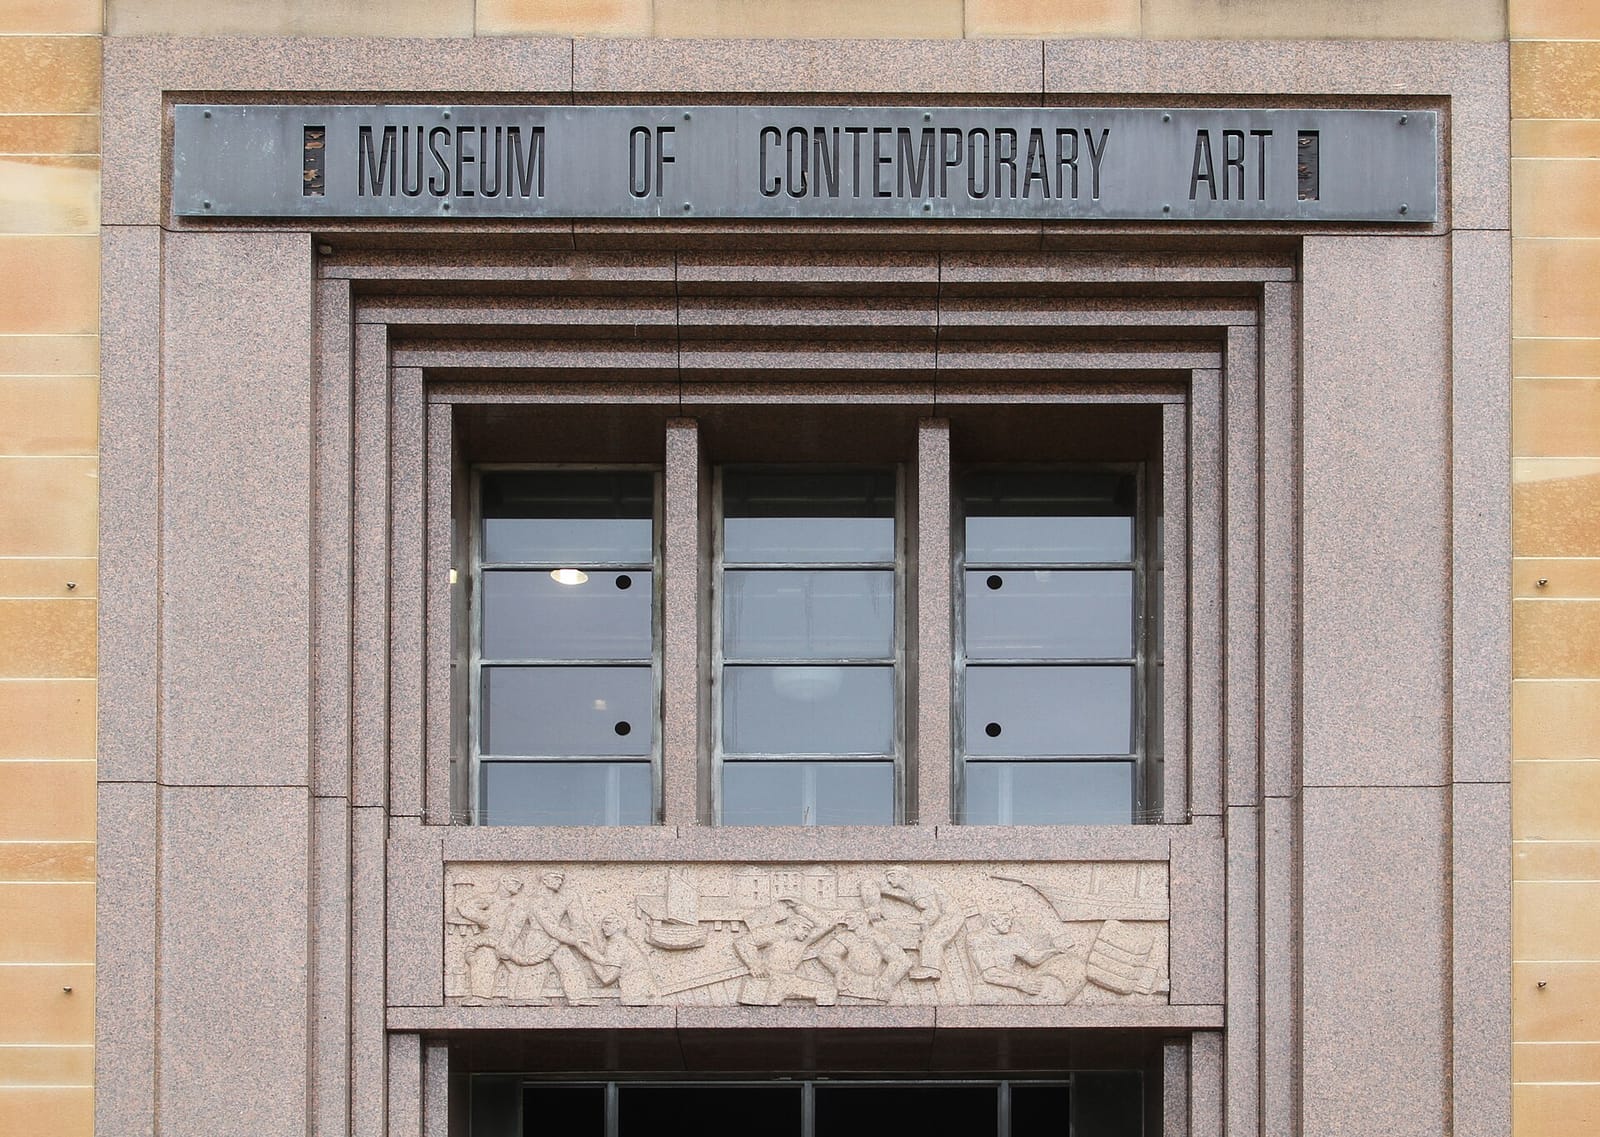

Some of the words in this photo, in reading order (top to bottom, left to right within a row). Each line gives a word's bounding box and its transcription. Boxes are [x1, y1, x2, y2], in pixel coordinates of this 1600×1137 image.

[357, 125, 546, 199] MUSEUM
[629, 125, 677, 199] OF
[758, 126, 1110, 200] CONTEMPORARY
[1188, 129, 1274, 201] ART
